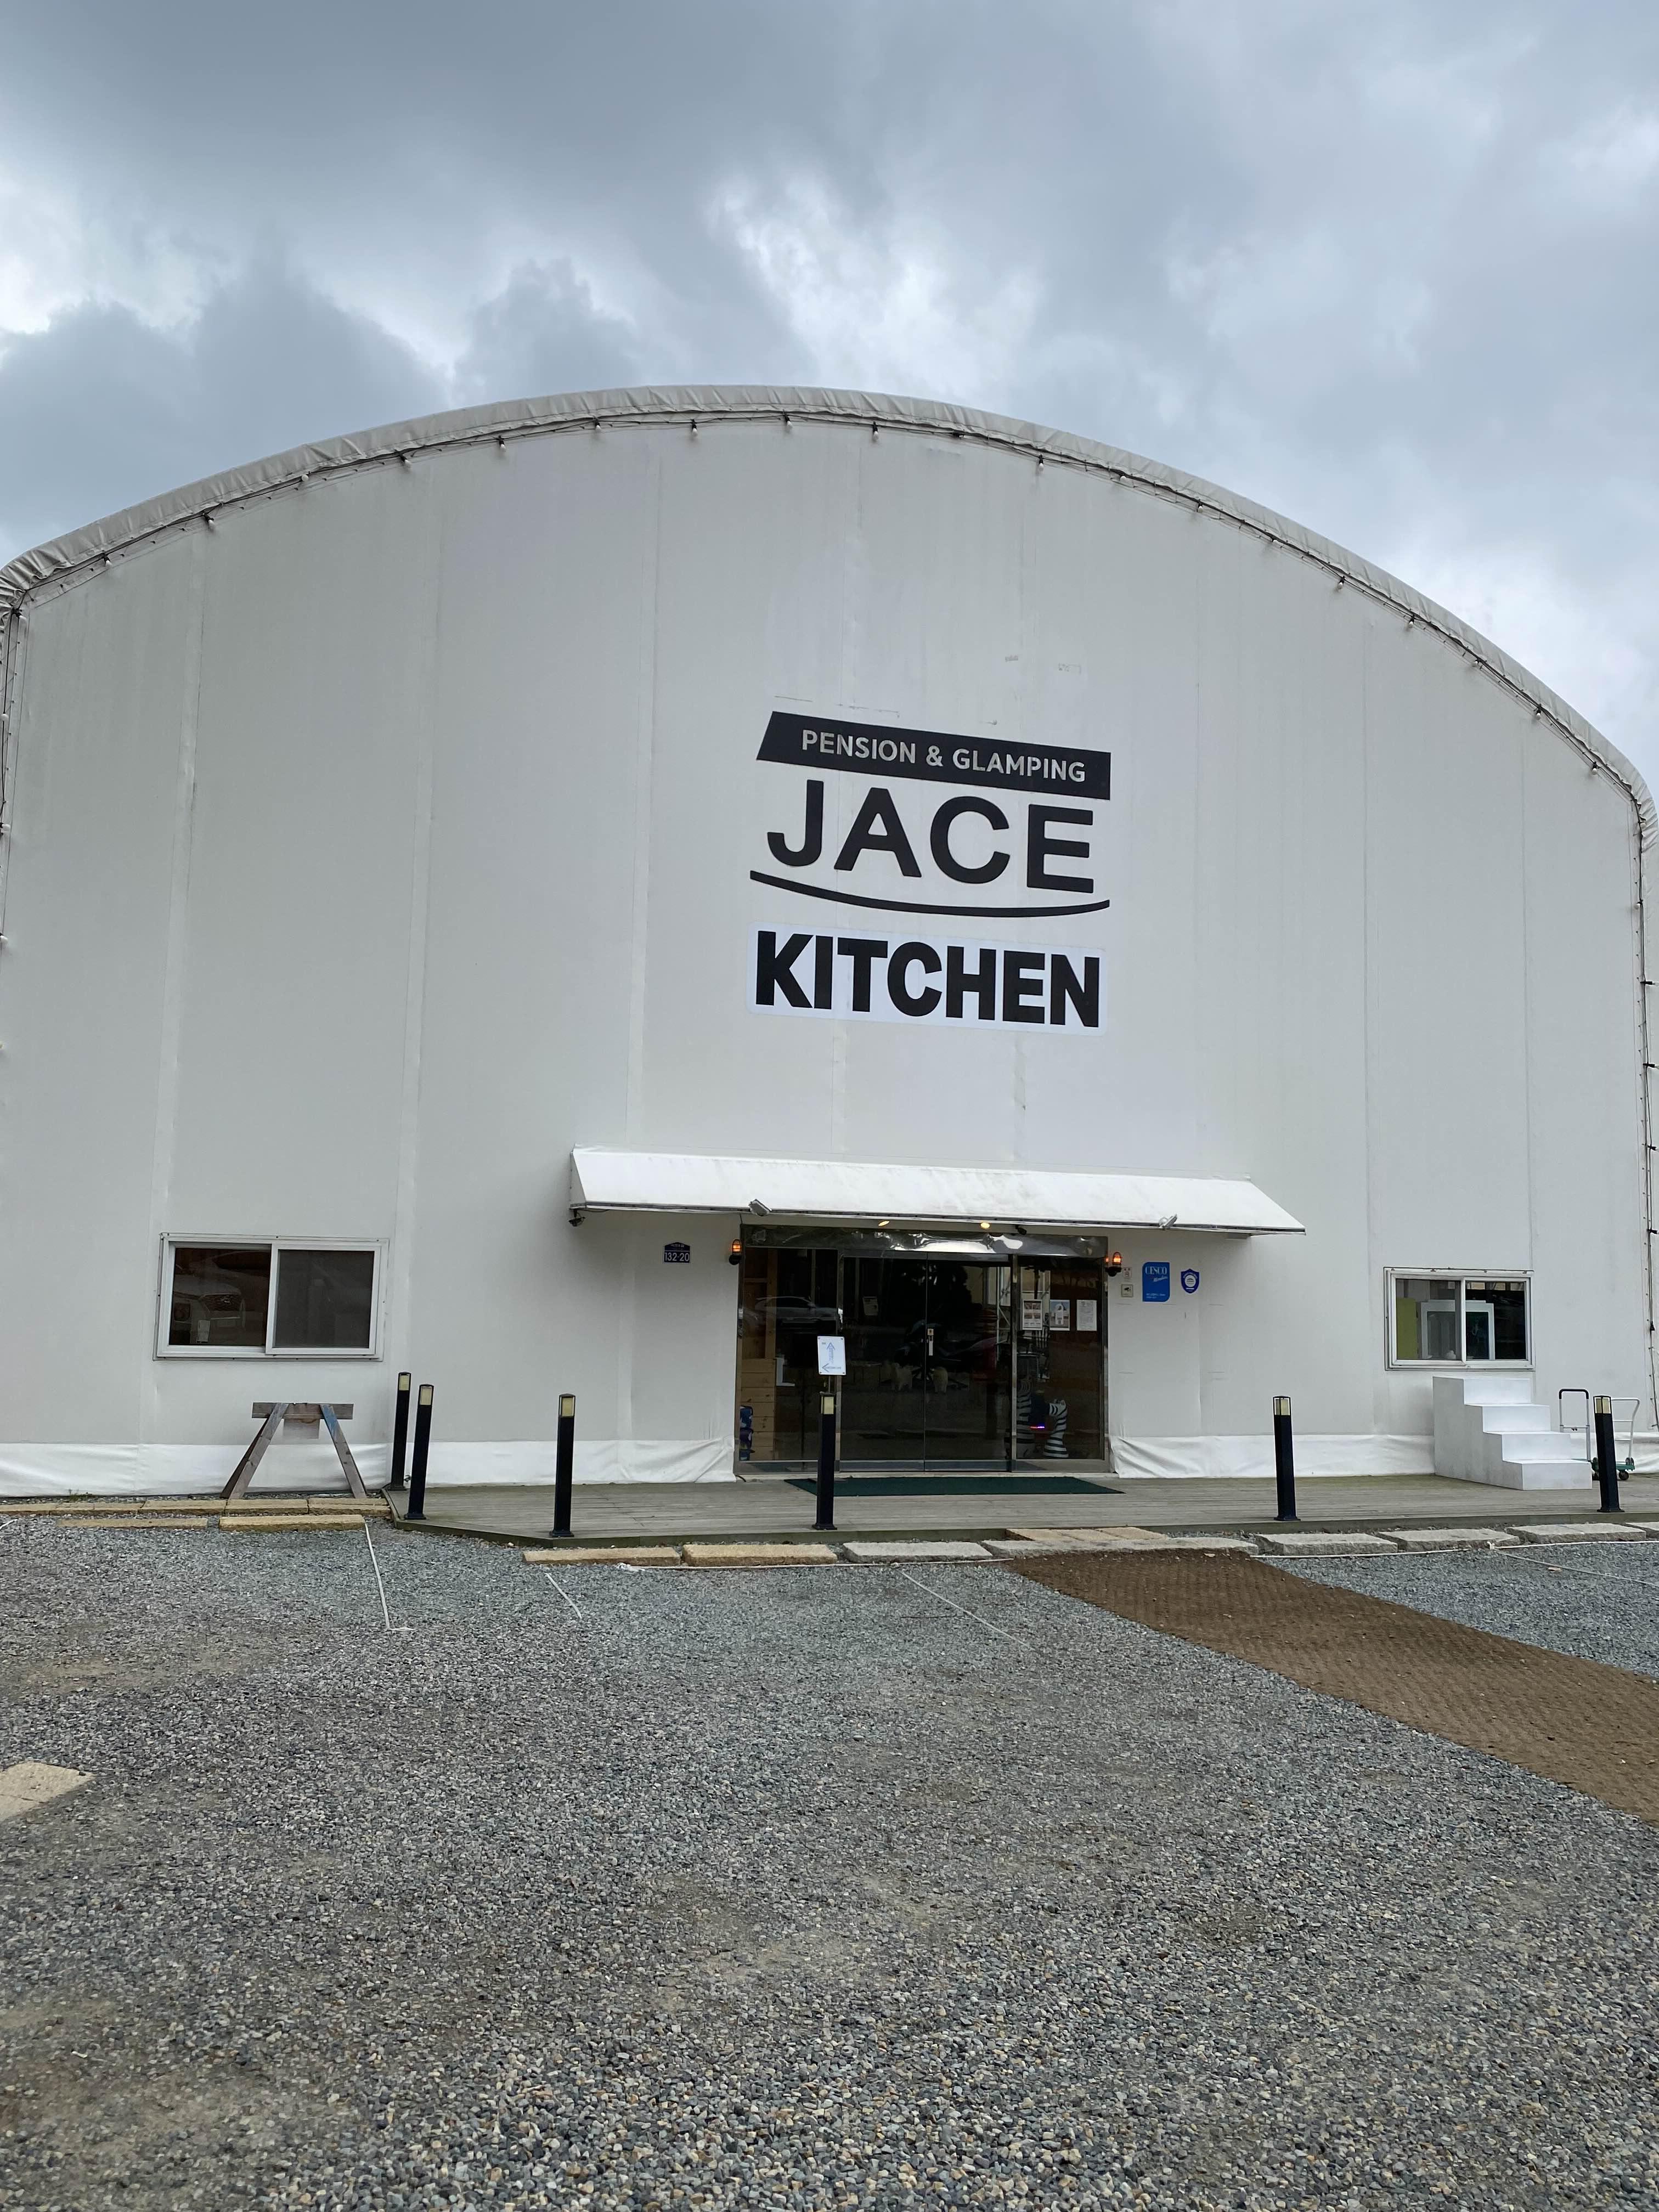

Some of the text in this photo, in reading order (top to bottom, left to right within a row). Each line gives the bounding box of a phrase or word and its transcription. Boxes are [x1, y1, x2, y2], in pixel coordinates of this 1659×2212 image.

[802, 729, 1085, 782] PENSION & GLAMPING
[767, 779, 1094, 894] JACE
[755, 930, 1100, 1028] KITCHEN
[665, 1252, 690, 1262] 132-20
